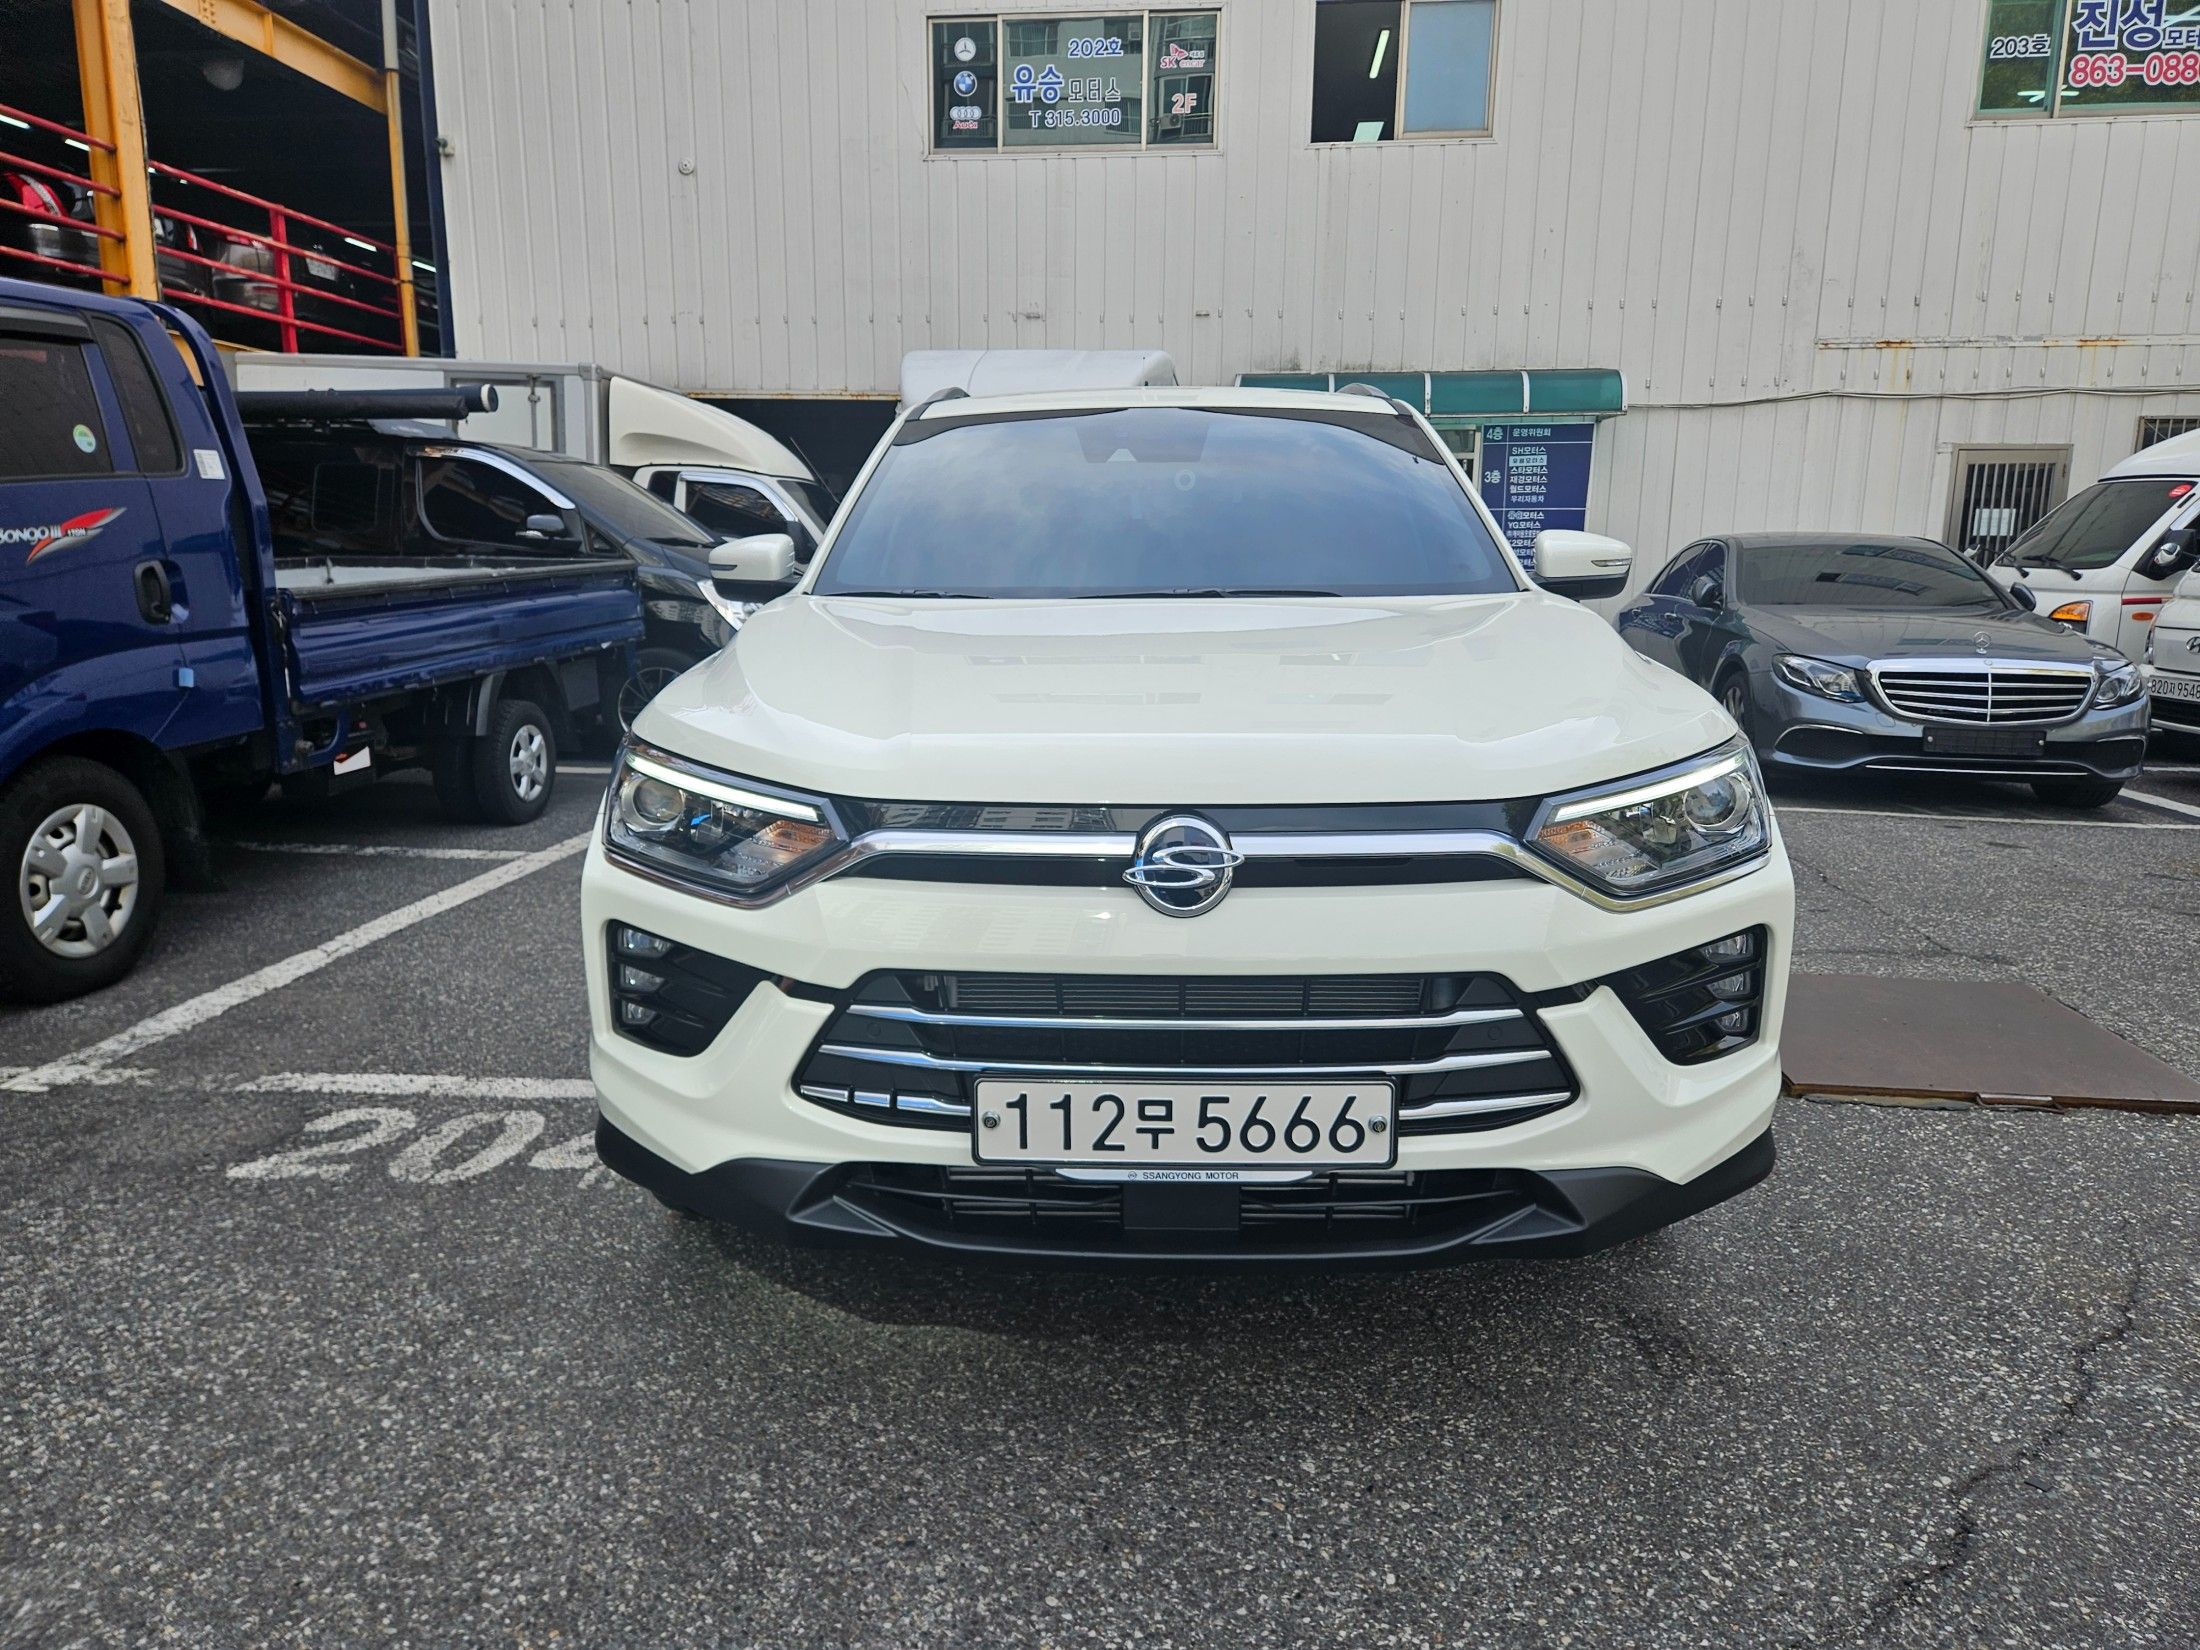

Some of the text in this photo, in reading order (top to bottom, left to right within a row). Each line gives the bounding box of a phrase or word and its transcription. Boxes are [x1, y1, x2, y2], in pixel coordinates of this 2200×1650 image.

[2074, 0, 2164, 49] 진성
[1068, 37, 1122, 58] 202호
[1991, 34, 2050, 57] 203호
[1161, 56, 1177, 68] SK
[1011, 65, 1121, 103] 유승 모터스
[1172, 93, 1197, 113] 2F
[1030, 108, 1121, 127] T 315.3000
[1486, 426, 1503, 440] 4층
[1512, 446, 1547, 455] SH모터스
[1484, 470, 1501, 484] 3층
[1510, 466, 1548, 474] 스타모터스
[1005, 1093, 1366, 1153] 112무 5666
[1142, 1170, 1239, 1180] SSANGYONG MOTOR
